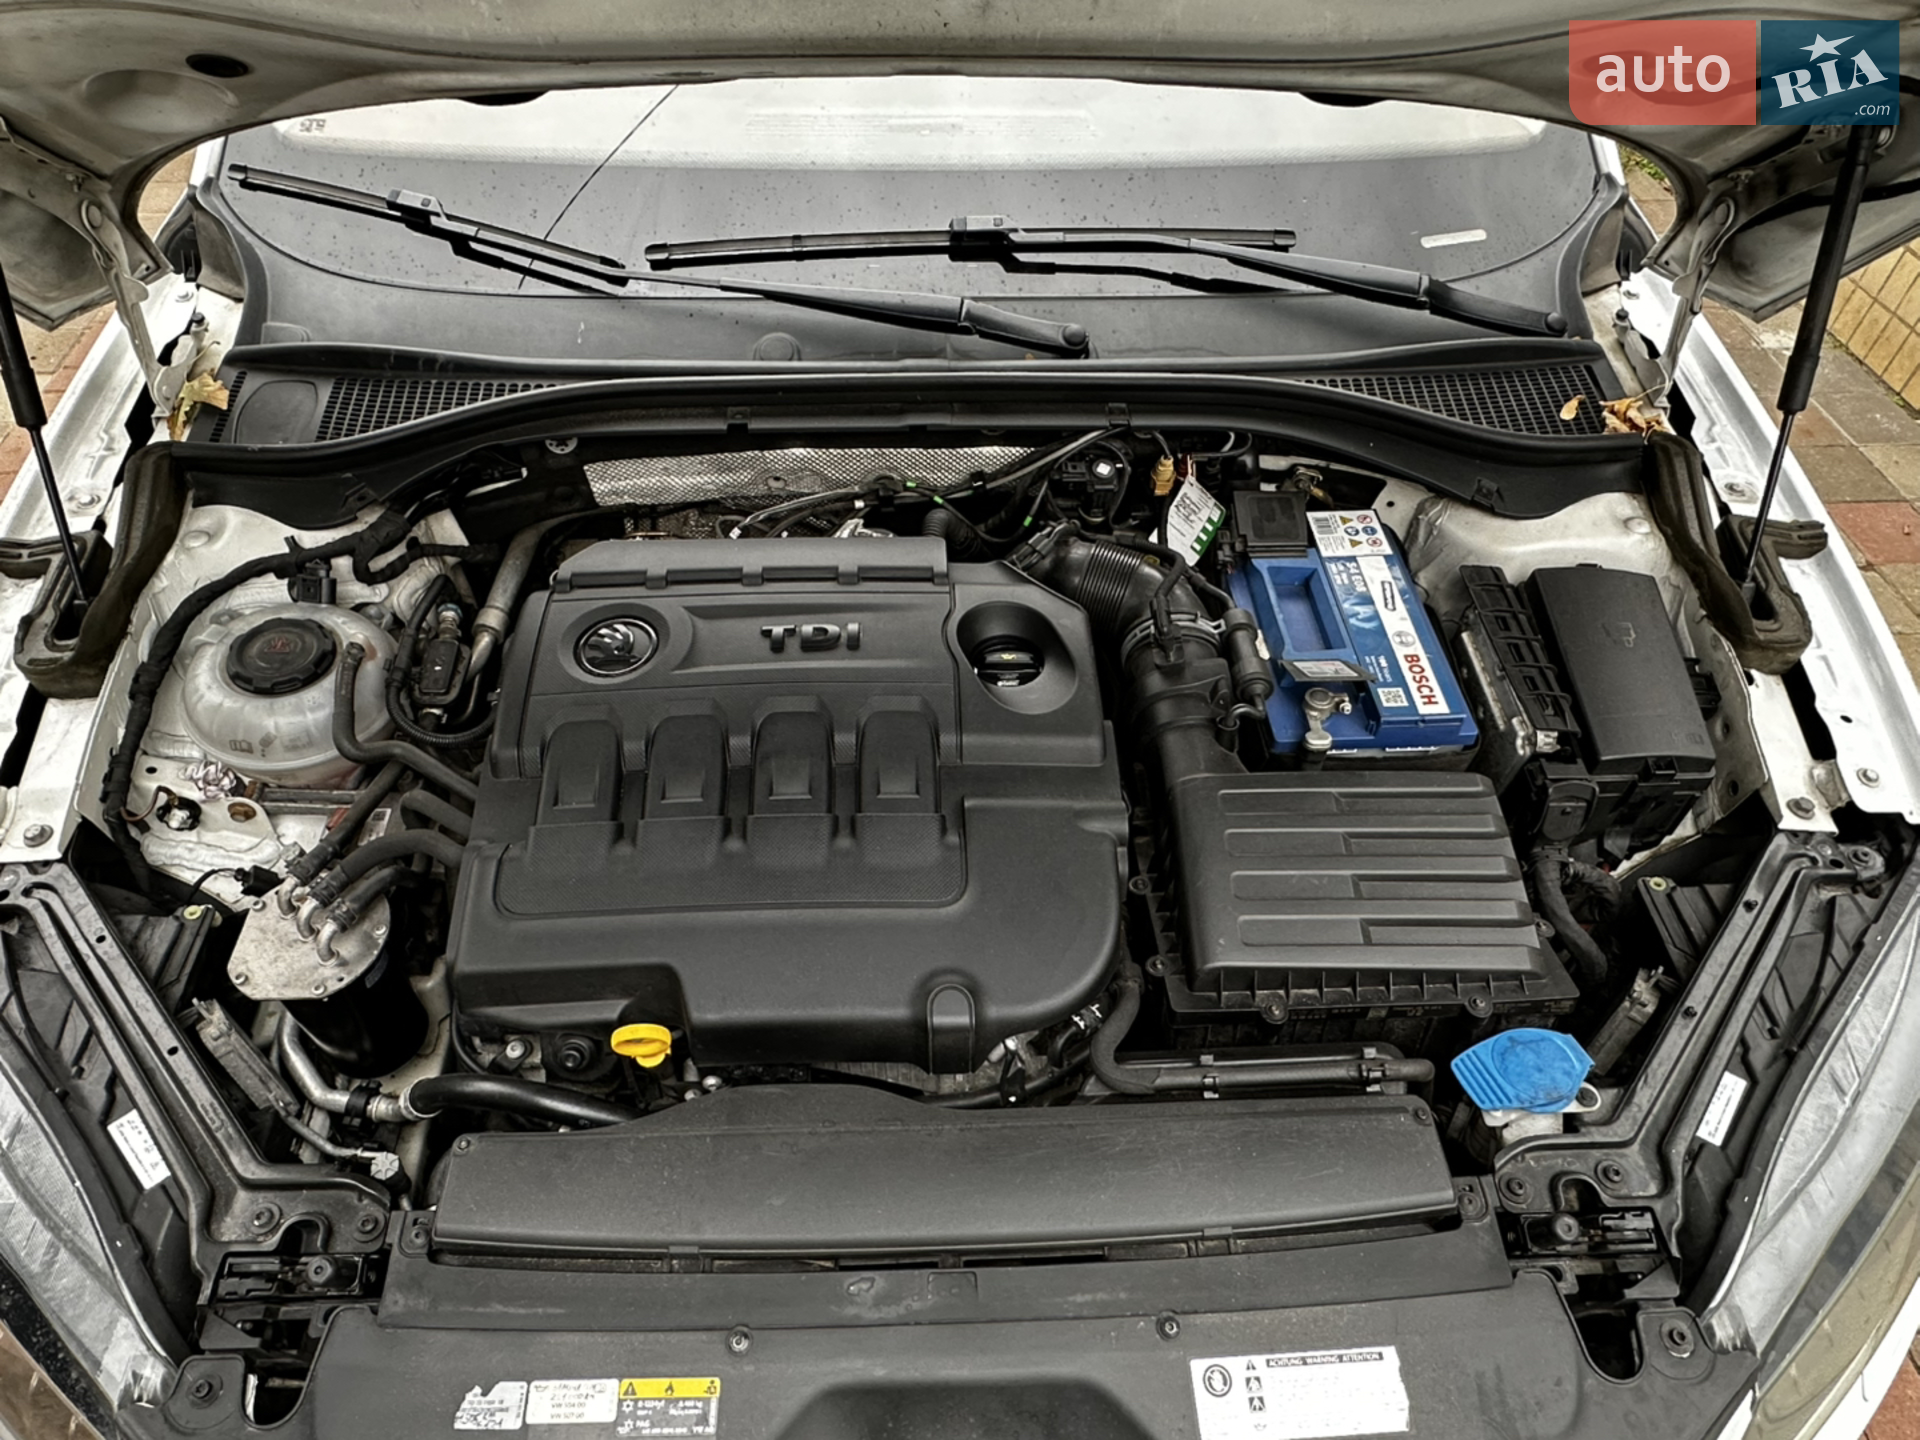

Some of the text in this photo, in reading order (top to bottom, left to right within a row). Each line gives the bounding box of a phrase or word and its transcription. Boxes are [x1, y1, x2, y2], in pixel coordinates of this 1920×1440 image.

[760, 622, 861, 654] TDI
[1403, 653, 1440, 706] BOSCH
[1269, 1352, 1380, 1367] ACHTUNG WARNING ATTENTION
